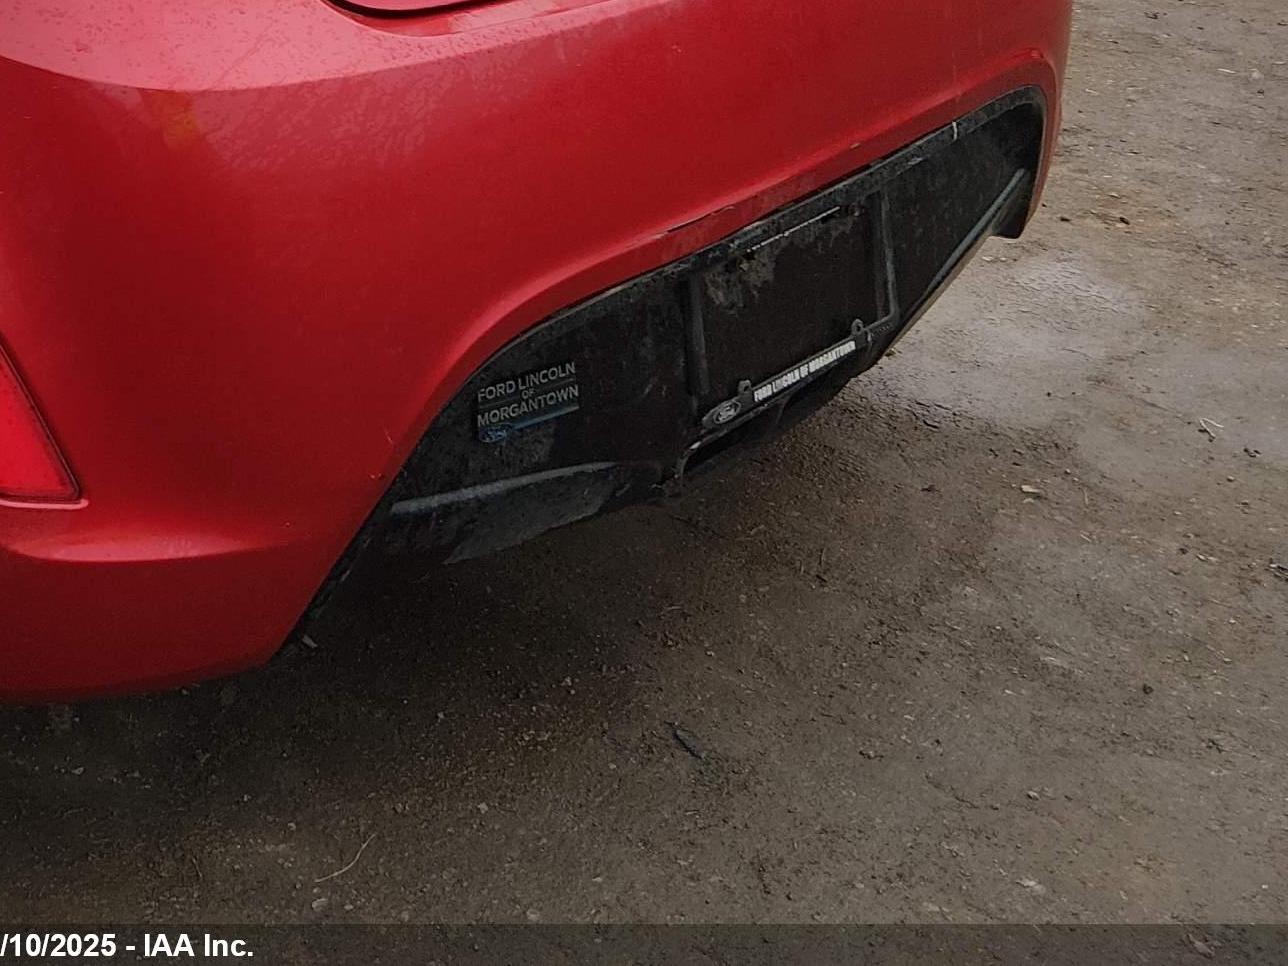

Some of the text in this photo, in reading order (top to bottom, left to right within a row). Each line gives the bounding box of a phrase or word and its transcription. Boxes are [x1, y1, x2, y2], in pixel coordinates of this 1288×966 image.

[478, 362, 576, 403] FORD LINCOLN
[477, 384, 580, 427] MORGANTOWN
